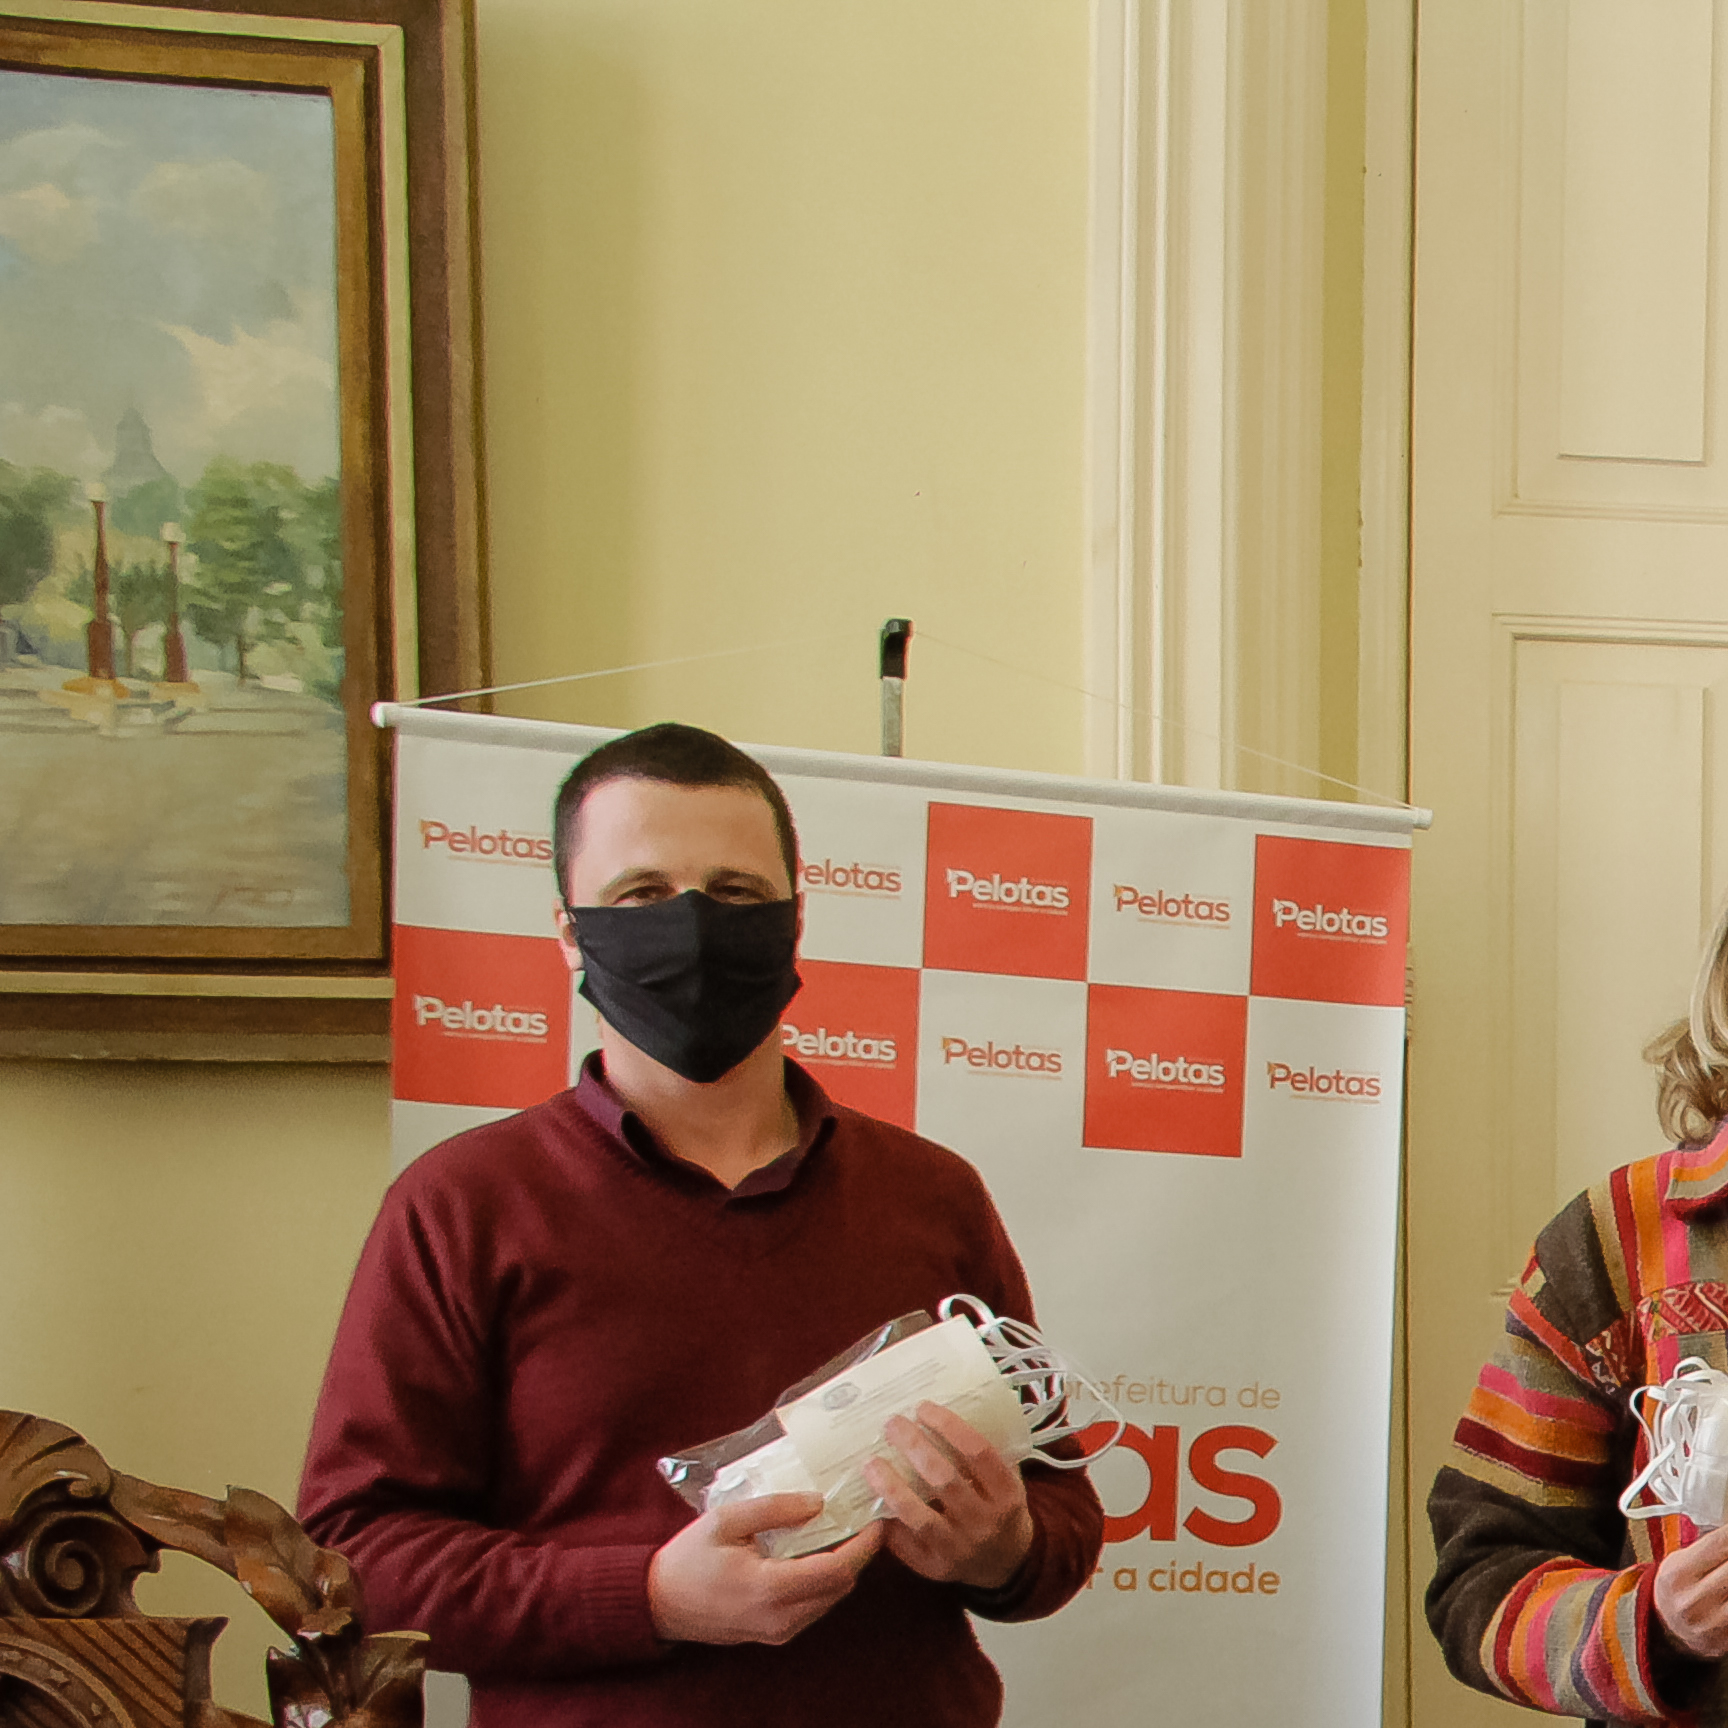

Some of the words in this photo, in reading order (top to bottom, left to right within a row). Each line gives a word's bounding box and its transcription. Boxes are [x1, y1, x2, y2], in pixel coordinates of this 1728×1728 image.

[420, 818, 555, 861] Pelotas
[802, 858, 902, 893] elotas
[946, 867, 1070, 909] Pelotas
[1114, 883, 1231, 922] Pelotas
[1272, 897, 1389, 938] Pelotas
[412, 993, 549, 1036] Pelotas
[942, 1036, 1063, 1074] Pelotas
[1106, 1048, 1226, 1087] Pelotas
[1266, 1061, 1382, 1098] Pelotas
[1237, 1382, 1281, 1410] de
[1112, 1567, 1138, 1592] a
[1148, 1560, 1281, 1594] cidade
